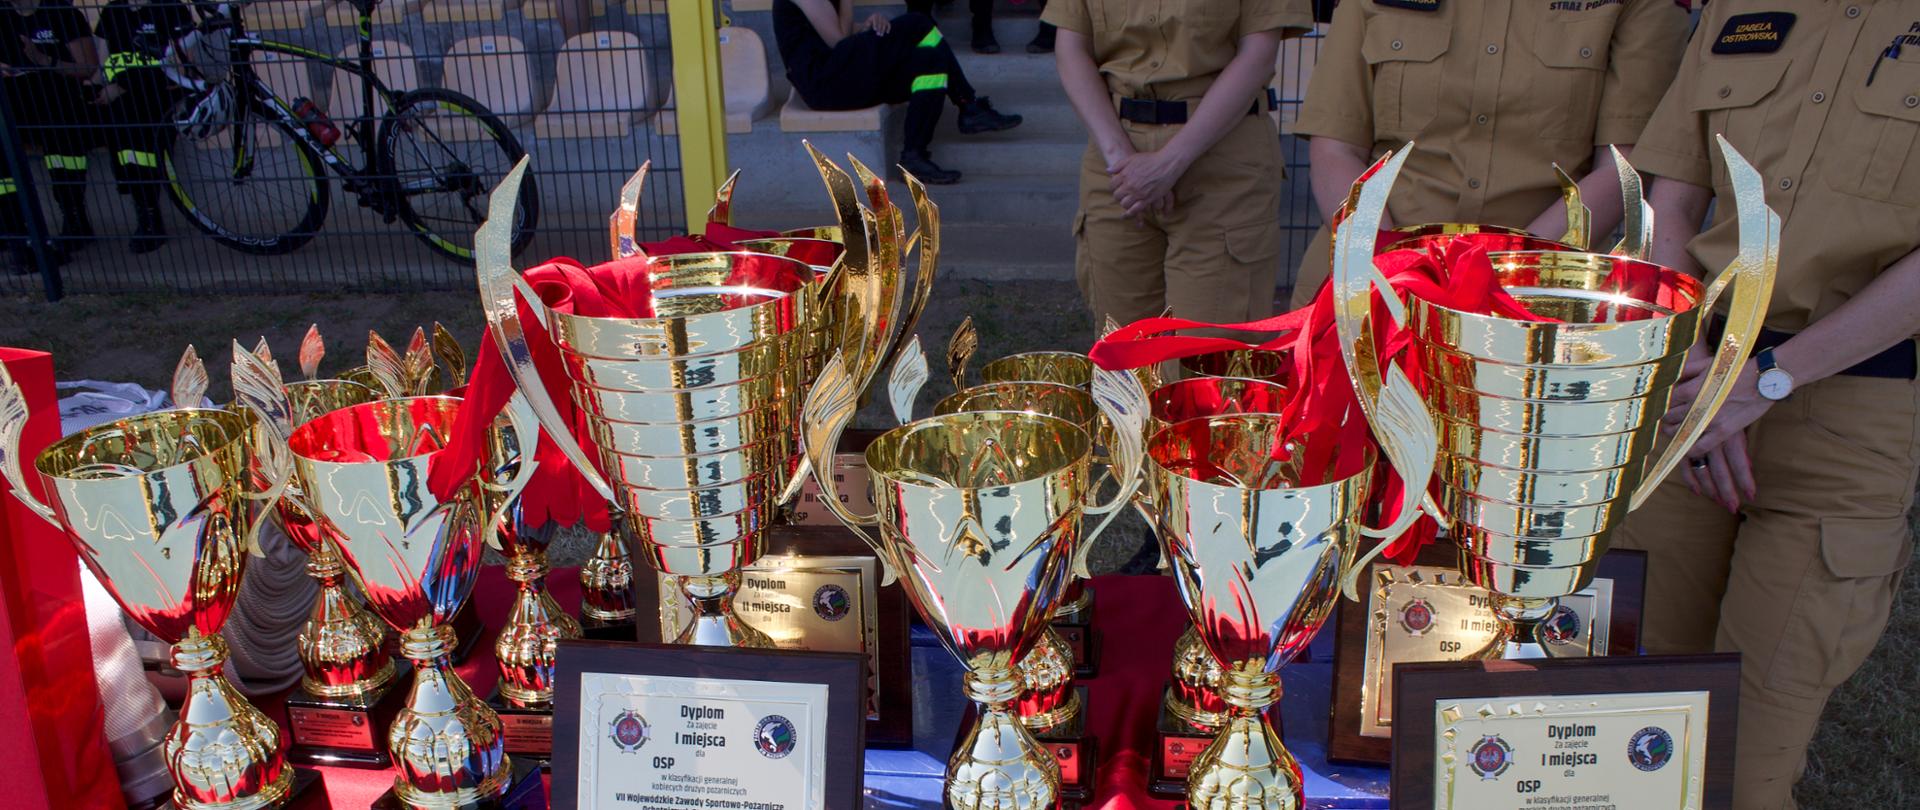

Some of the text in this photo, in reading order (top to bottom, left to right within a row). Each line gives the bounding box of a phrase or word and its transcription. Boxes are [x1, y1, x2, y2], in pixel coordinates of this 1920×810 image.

[1736, 22, 1773, 33] IZABELA
[1721, 32, 1778, 43] OSTROWSKA
[747, 578, 787, 592] Dyplom
[742, 601, 791, 614] II miejsca
[1469, 594, 1489, 608] Dyp
[1460, 619, 1500, 633] II miejs
[1440, 640, 1462, 653] OSP
[681, 705, 725, 721] Dyplom
[1548, 723, 1596, 740] Dyplom
[675, 732, 726, 748] I miejsca
[1554, 741, 1563, 749] Za
[695, 750, 706, 758] dla
[1541, 752, 1597, 767] I miejsca
[653, 756, 675, 769] OSP
[1563, 769, 1575, 777] dla
[704, 776, 738, 787] generalnej
[1517, 780, 1541, 793] OSP
[616, 792, 625, 801] VII
[675, 796, 703, 808] Zawody
[1573, 793, 1610, 804] generalnej
